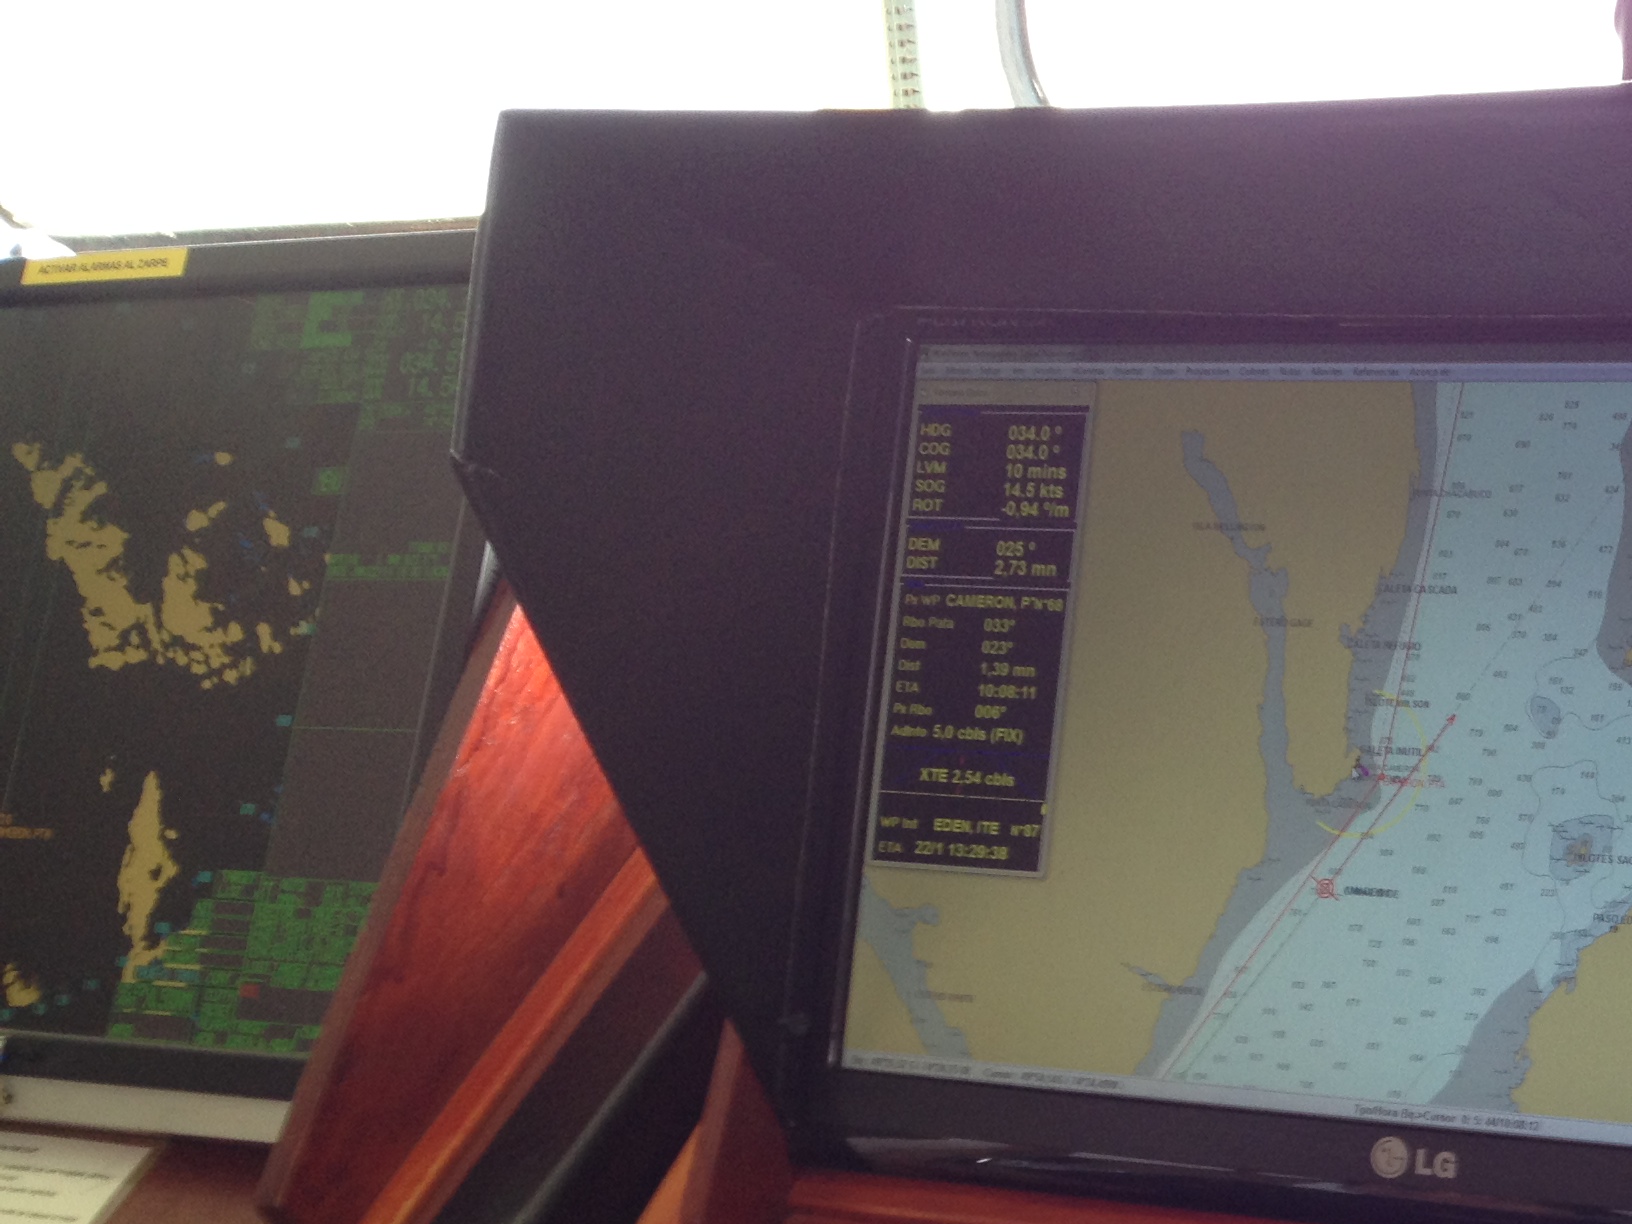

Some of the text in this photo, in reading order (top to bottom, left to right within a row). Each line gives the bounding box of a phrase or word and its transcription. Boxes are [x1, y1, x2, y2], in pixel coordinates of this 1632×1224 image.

[38, 257, 168, 274] ACTIVAR ALARMAS AL ZARPE
[920, 424, 952, 437] HDG
[1008, 425, 1051, 442] 034.0
[919, 442, 951, 455] COG
[1006, 444, 1049, 459] 034.0
[916, 461, 1067, 479] LVM 10 mins
[915, 479, 1064, 498] SOG 14.5 kts
[912, 499, 943, 511] ROT
[908, 537, 940, 550] DEM
[996, 541, 1025, 556] 025
[906, 556, 938, 569] DIST
[895, 681, 920, 693] ETA
[919, 767, 949, 782] XTE
[1414, 1148, 1456, 1178] LG
